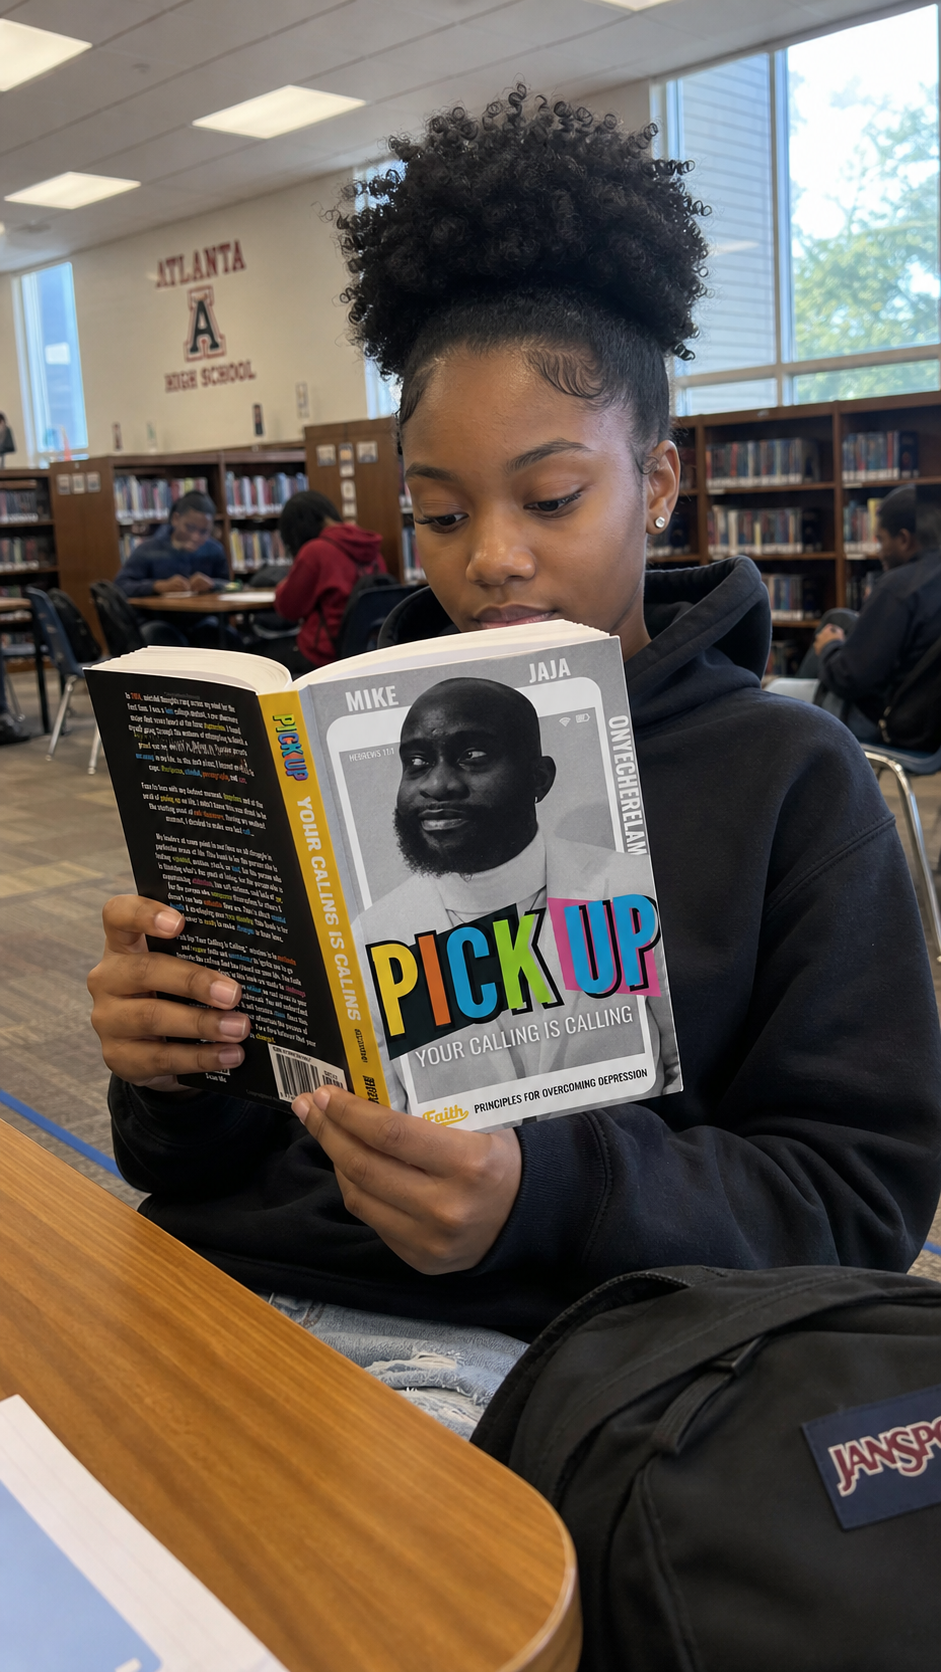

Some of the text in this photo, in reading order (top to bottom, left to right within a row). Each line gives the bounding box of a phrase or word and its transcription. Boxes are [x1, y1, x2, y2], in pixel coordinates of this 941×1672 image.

[156, 240, 245, 288] ATLANTA
[183, 284, 227, 362] A
[164, 359, 256, 393] HIGH SCHOOL
[529, 657, 572, 683] JAJA
[345, 685, 399, 712] MIKE
[608, 714, 649, 856] ONYECHERELAM
[329, 931, 345, 949] IS
[365, 893, 661, 1039] PICK UP
[415, 1005, 634, 1068] YOUR CALLING IS CALLING
[474, 1068, 648, 1114] PRINCIPLES FOR OVERCOMING DEPRESSION
[422, 1104, 469, 1125] Faith
